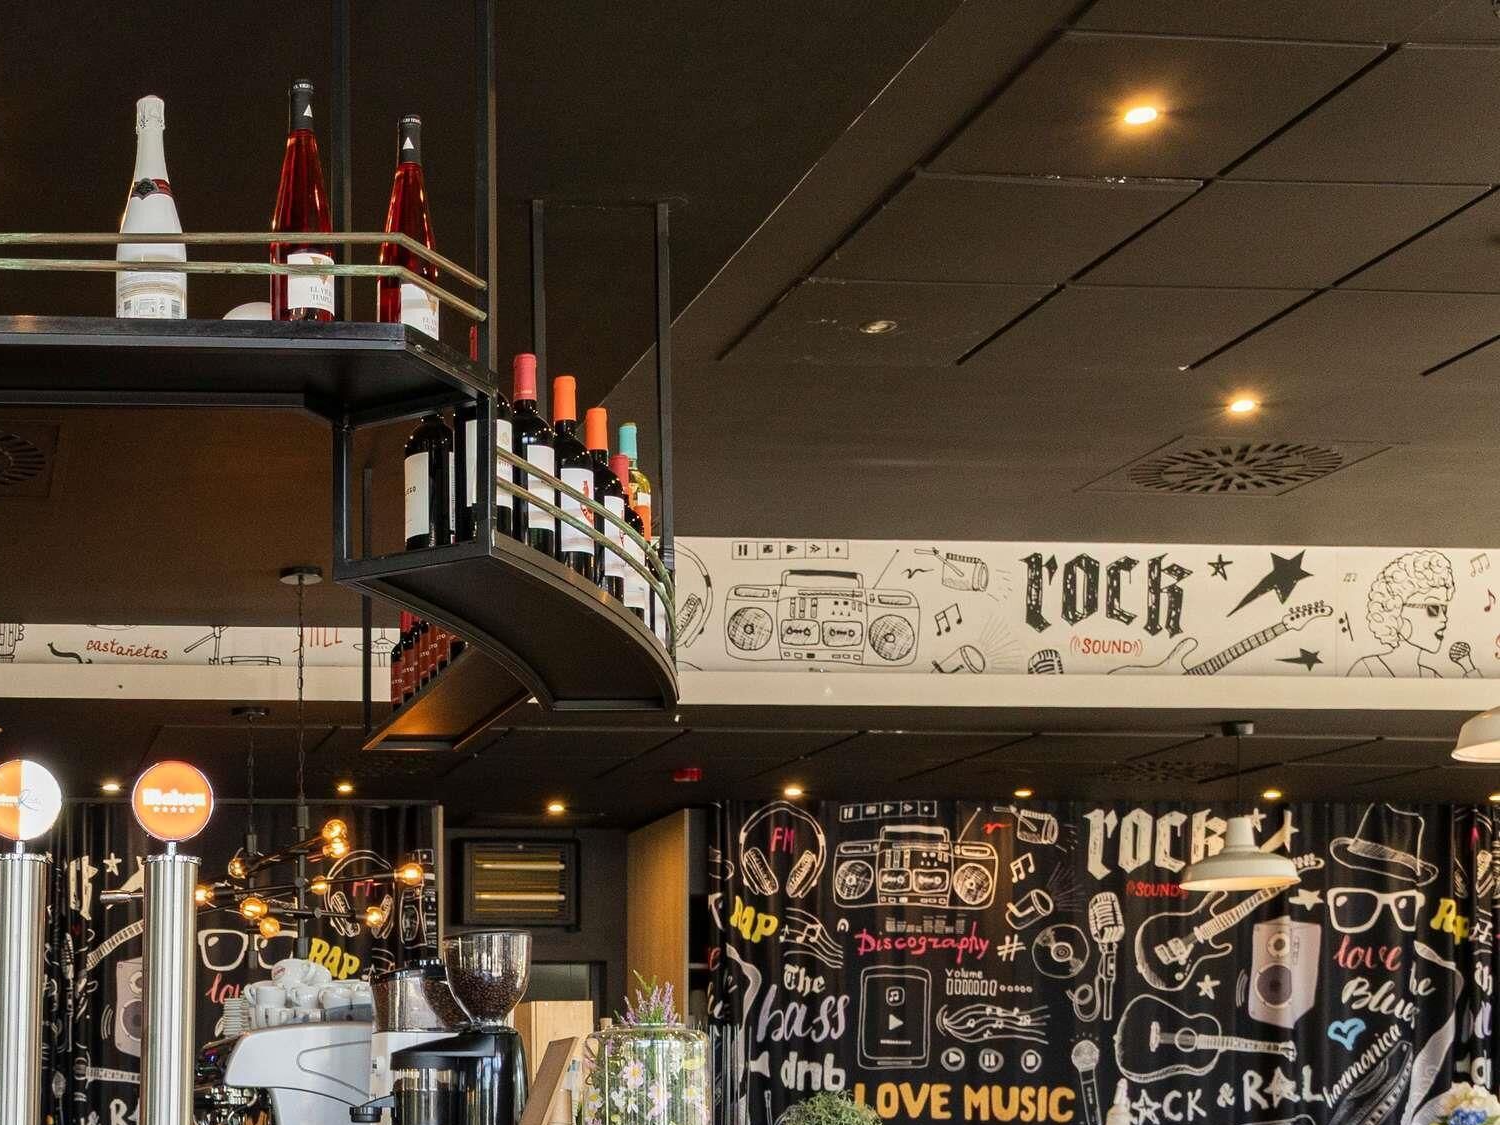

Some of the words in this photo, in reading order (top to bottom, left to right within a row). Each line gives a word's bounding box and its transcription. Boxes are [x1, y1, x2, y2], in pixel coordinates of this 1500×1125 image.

[86, 638, 169, 661] castañetas
[1081, 637, 1138, 655] SOUND
[771, 827, 795, 853] FM
[855, 922, 991, 966] Discography
[783, 963, 826, 994] The
[945, 968, 984, 980] Volume
[756, 983, 850, 1043] bass
[780, 1050, 846, 1093] dnb
[1322, 1023, 1402, 1109] harmonica
[963, 1085, 1077, 1123] MUSIC
